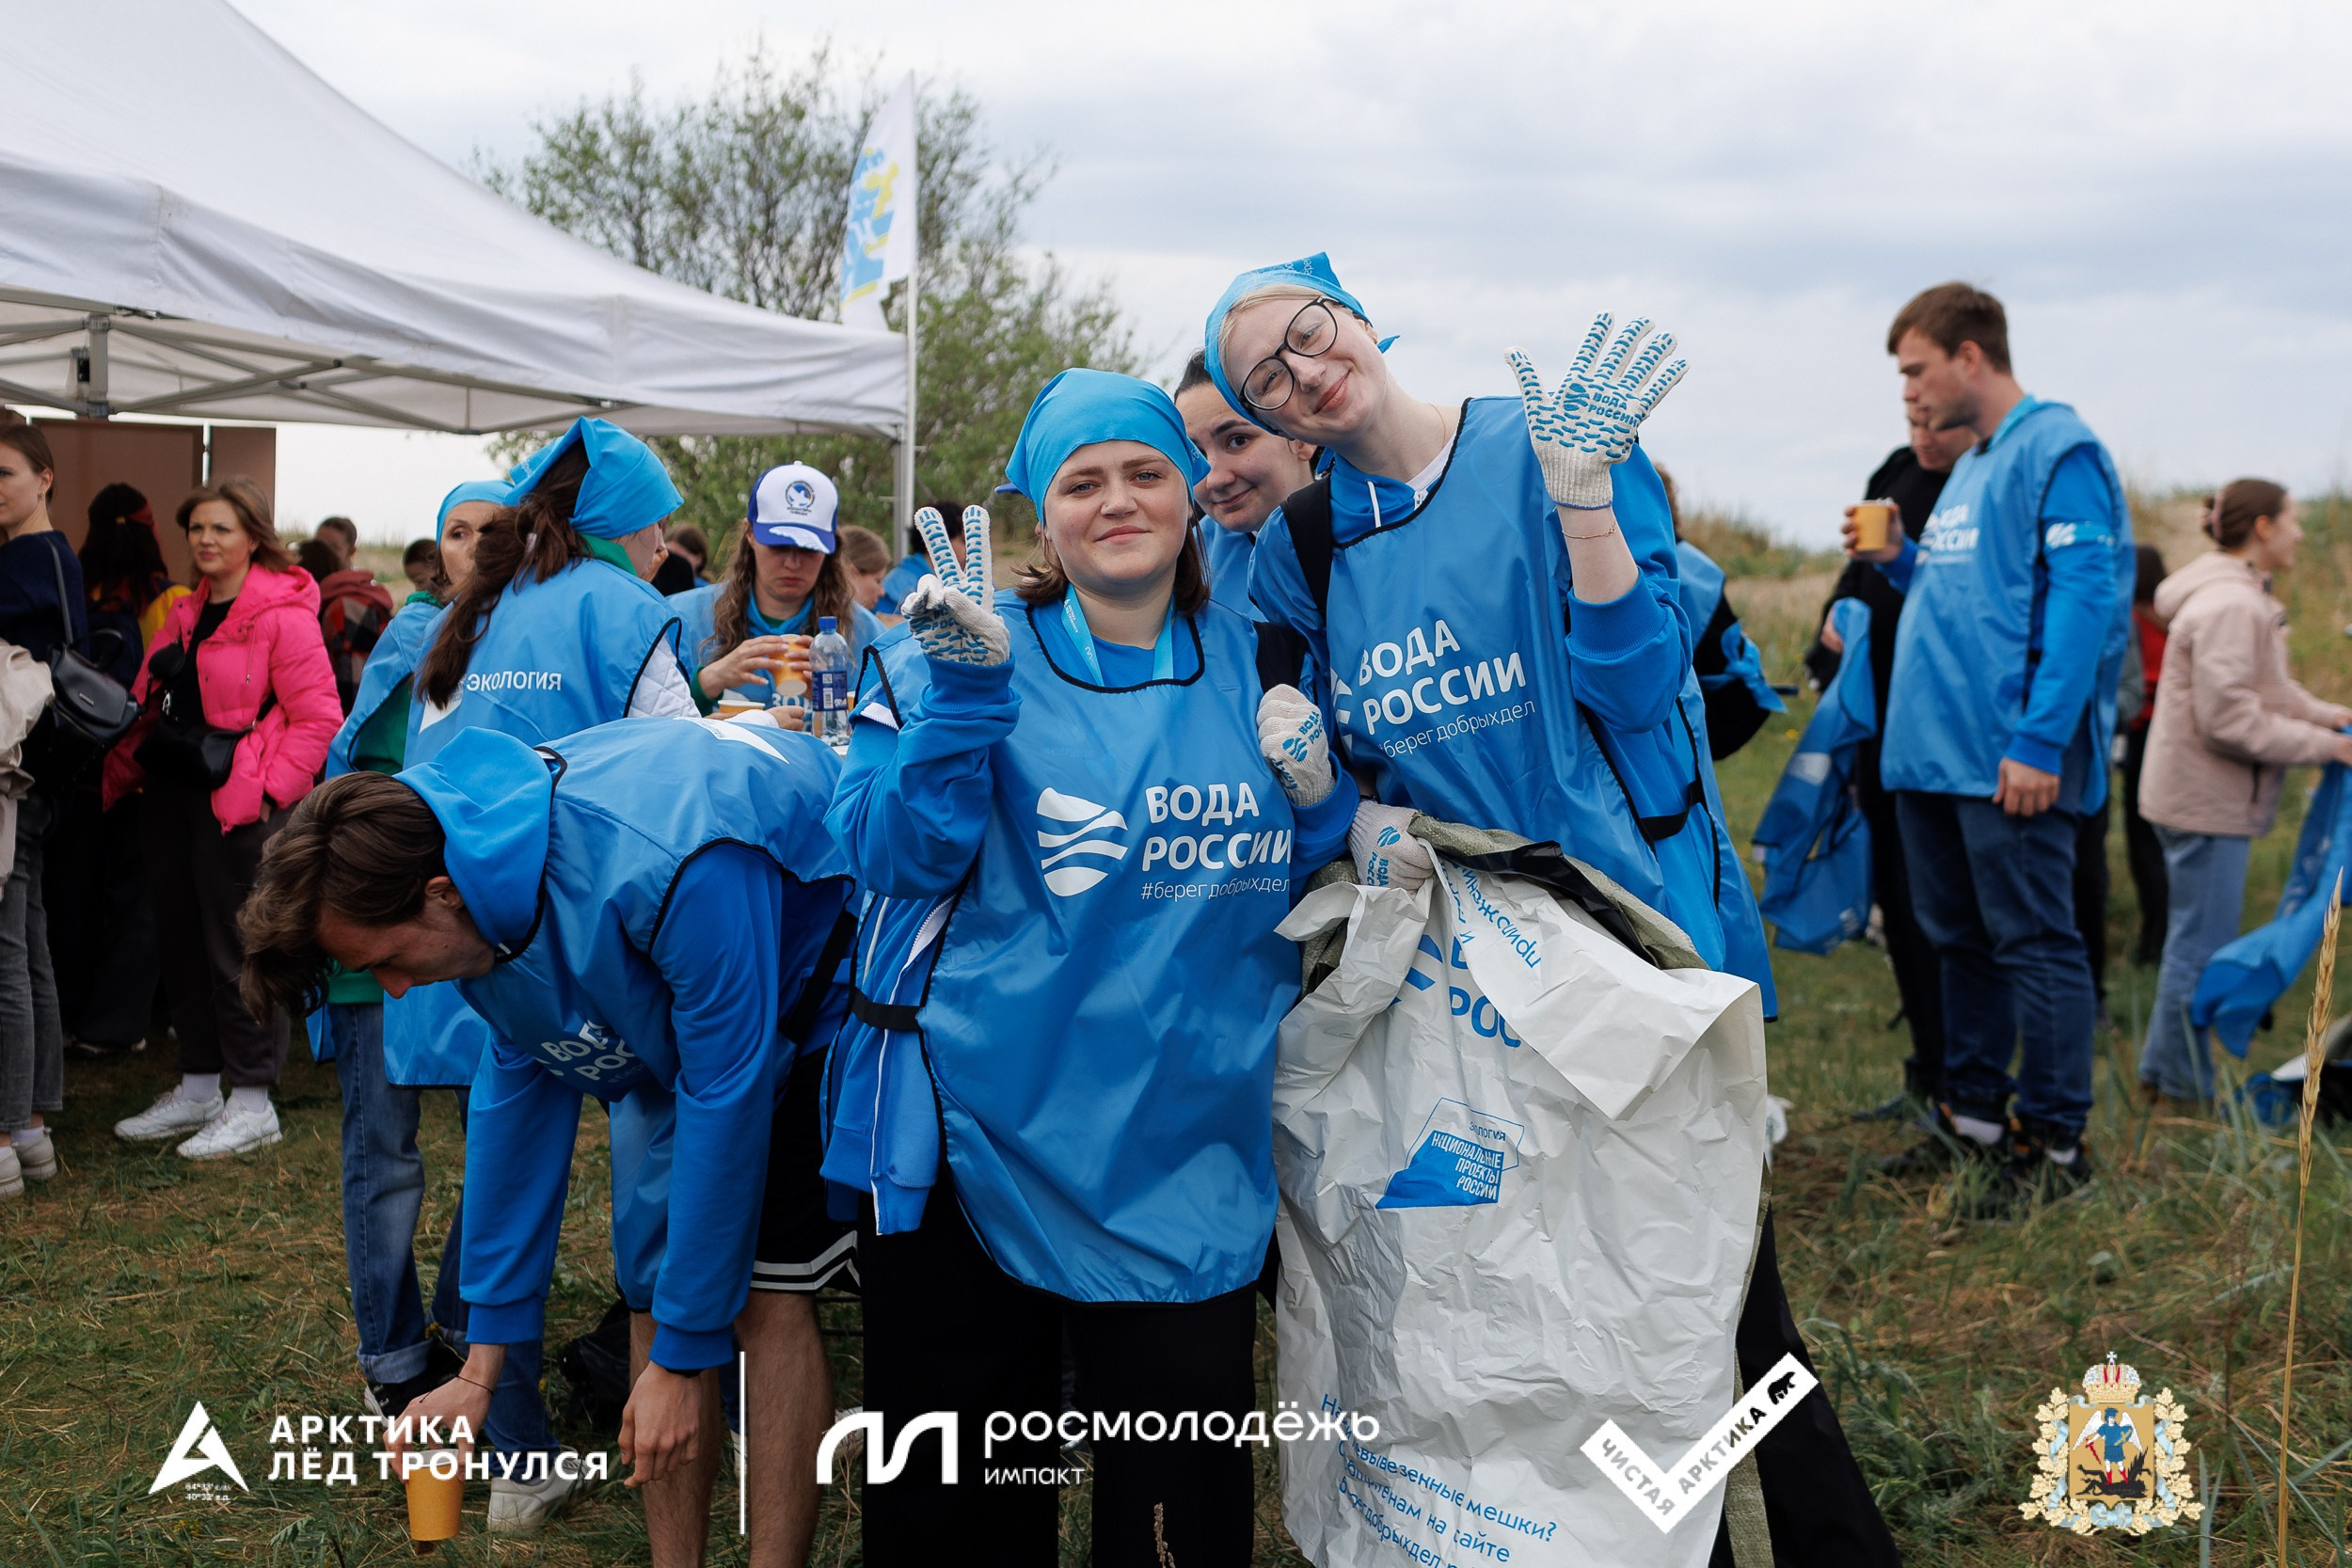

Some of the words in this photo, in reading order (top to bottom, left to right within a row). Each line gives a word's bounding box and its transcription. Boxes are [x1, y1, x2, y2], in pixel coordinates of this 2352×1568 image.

[1593, 391, 1629, 411] ВОДА
[1588, 404, 1637, 428] РОССИИ
[1359, 619, 1461, 686] ВОДА
[467, 671, 562, 691] ЭКОЛОГИЯ
[1362, 652, 1526, 736] РОССИИ
[1145, 782, 1260, 827] ВОДА
[1141, 829, 1292, 872] РОССИИ
[1454, 1157, 1500, 1185] ПРОЕКТЫ
[1456, 1175, 1498, 1200] РОССИИ
[1426, 1513, 1448, 1535] на
[1467, 1499, 1558, 1544] мешки?
